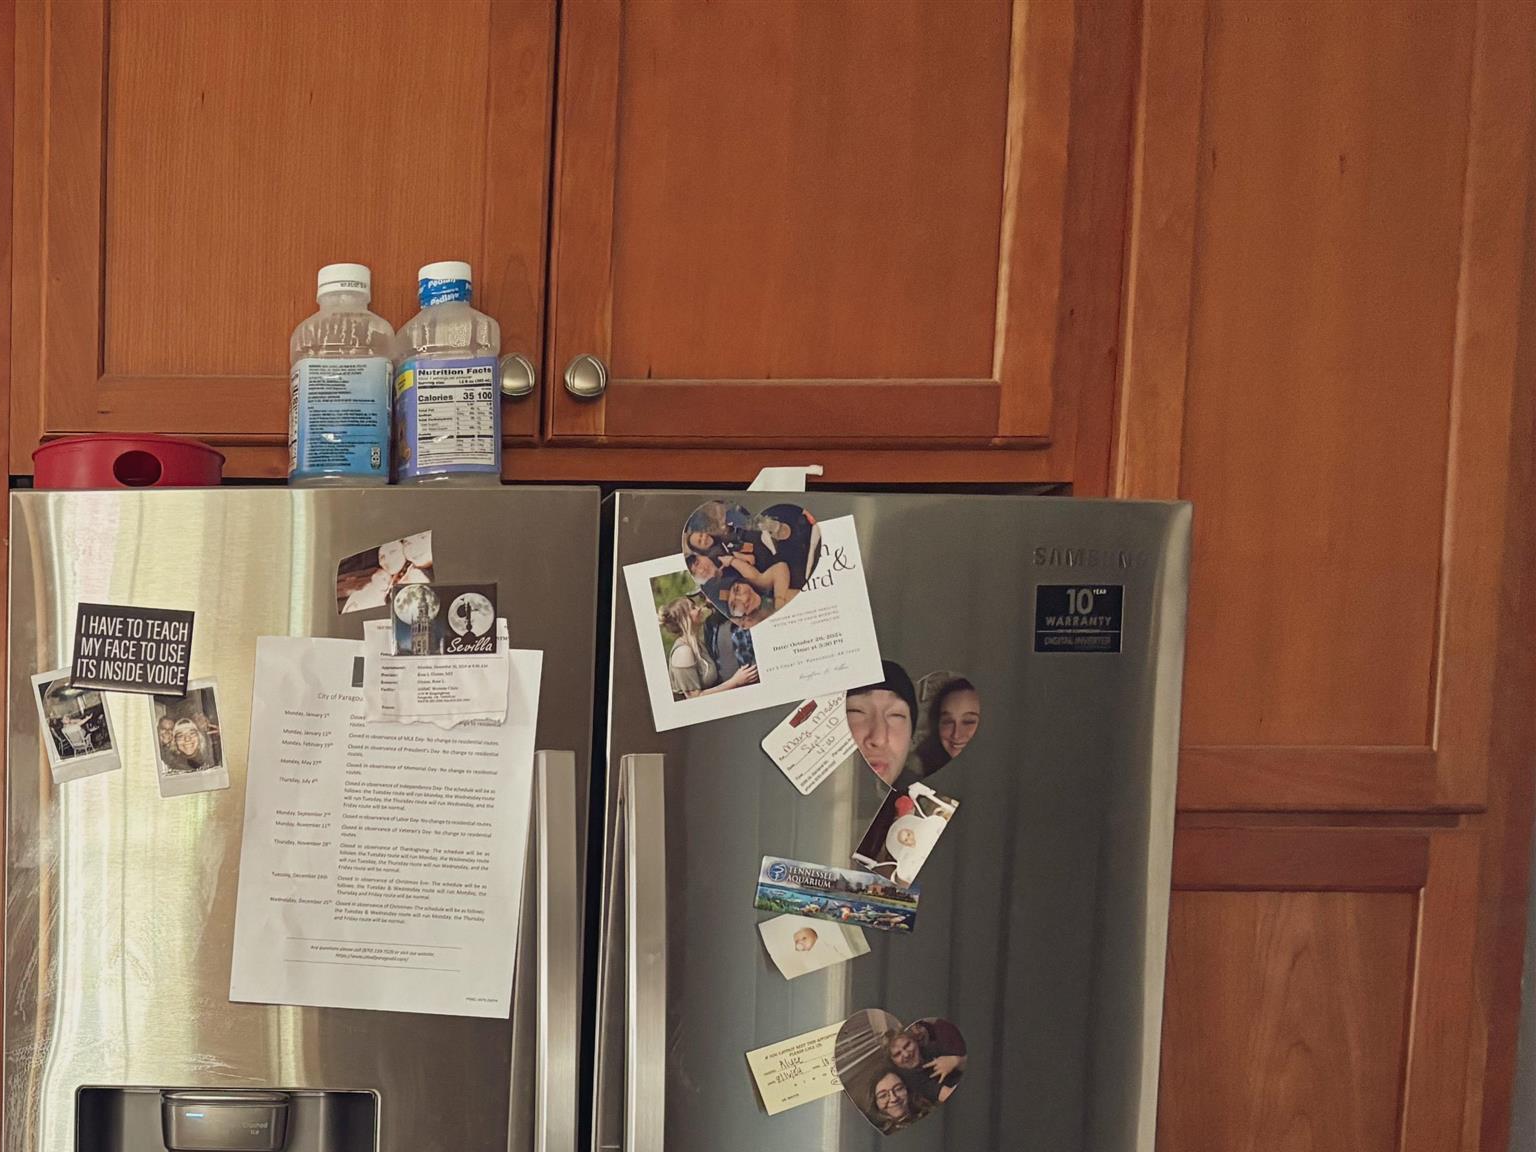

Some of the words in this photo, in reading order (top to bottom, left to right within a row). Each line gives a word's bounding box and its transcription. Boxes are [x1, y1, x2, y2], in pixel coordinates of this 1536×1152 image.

[418, 394, 454, 402] Calories
[462, 392, 475, 400] 35
[477, 392, 492, 400] 100
[1066, 588, 1094, 615] 10
[81, 615, 86, 634] I
[89, 615, 124, 637] HAVE
[126, 618, 143, 638] TO
[146, 620, 189, 641] TEACH
[1045, 616, 1112, 626] WARRANTY
[80, 637, 102, 657] MY
[104, 639, 137, 659] FACE
[139, 641, 156, 661] TO
[159, 643, 186, 664] USE
[446, 636, 493, 653] Sevilla
[76, 658, 97, 678] ITS
[99, 660, 144, 682] INSIDE
[147, 664, 186, 686] VOICE
[317, 692, 329, 700] City
[337, 693, 363, 701] Paragou
[789, 866, 833, 880] TENNESSEE
[787, 874, 831, 888] AQUARIUM
